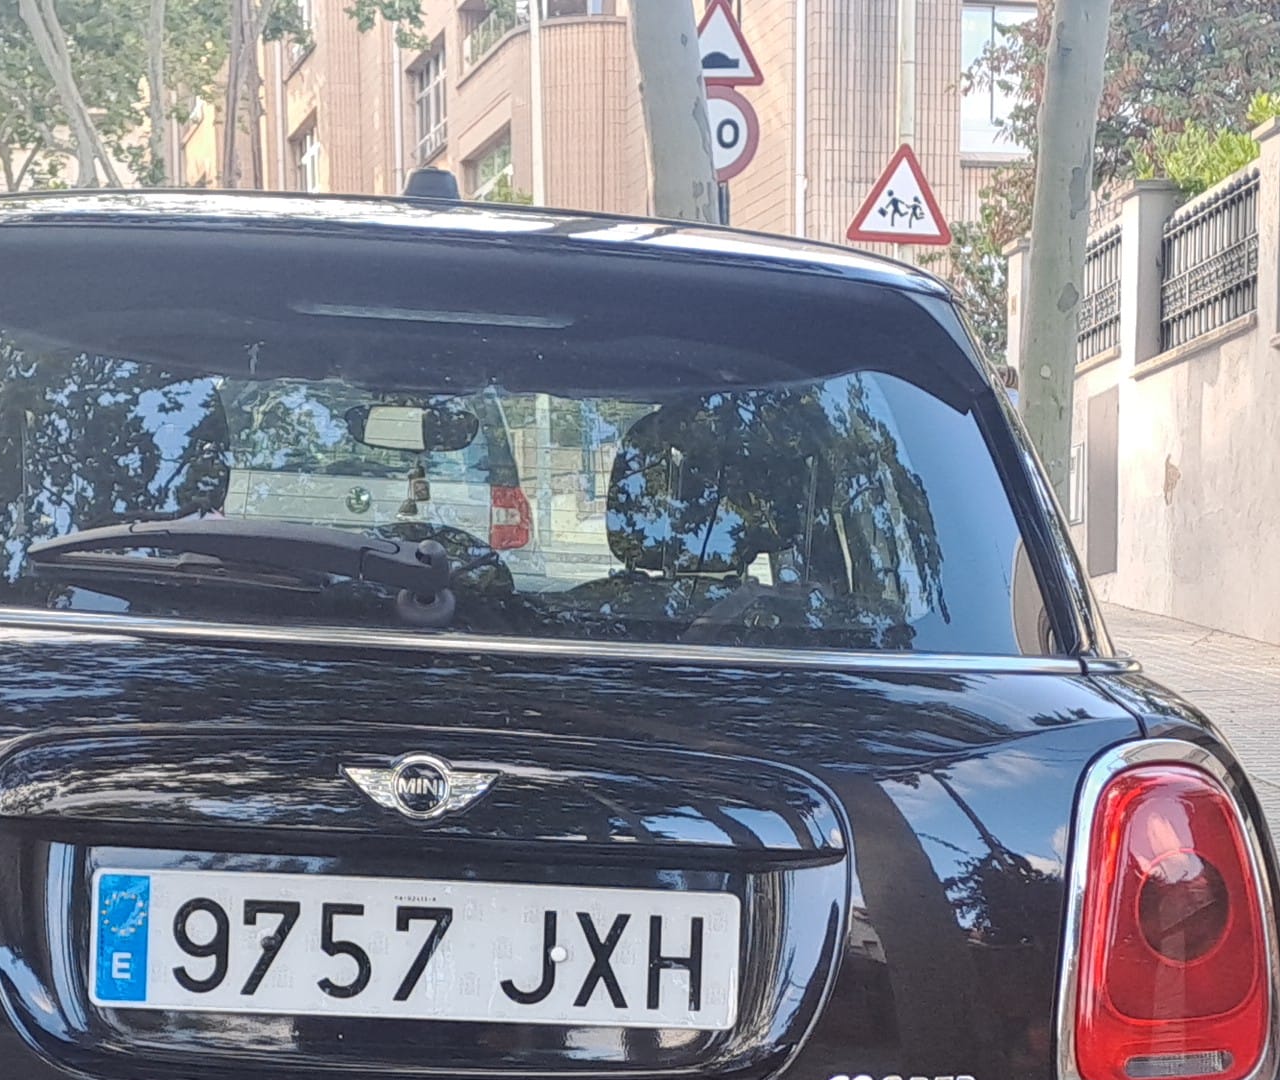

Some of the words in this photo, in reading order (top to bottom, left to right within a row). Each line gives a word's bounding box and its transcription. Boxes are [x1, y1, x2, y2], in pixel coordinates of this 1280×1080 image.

[716, 118, 740, 149] 0
[398, 777, 444, 796] MINI
[111, 951, 132, 980] E
[172, 896, 453, 1002] 9757
[499, 910, 704, 1012] JXH
